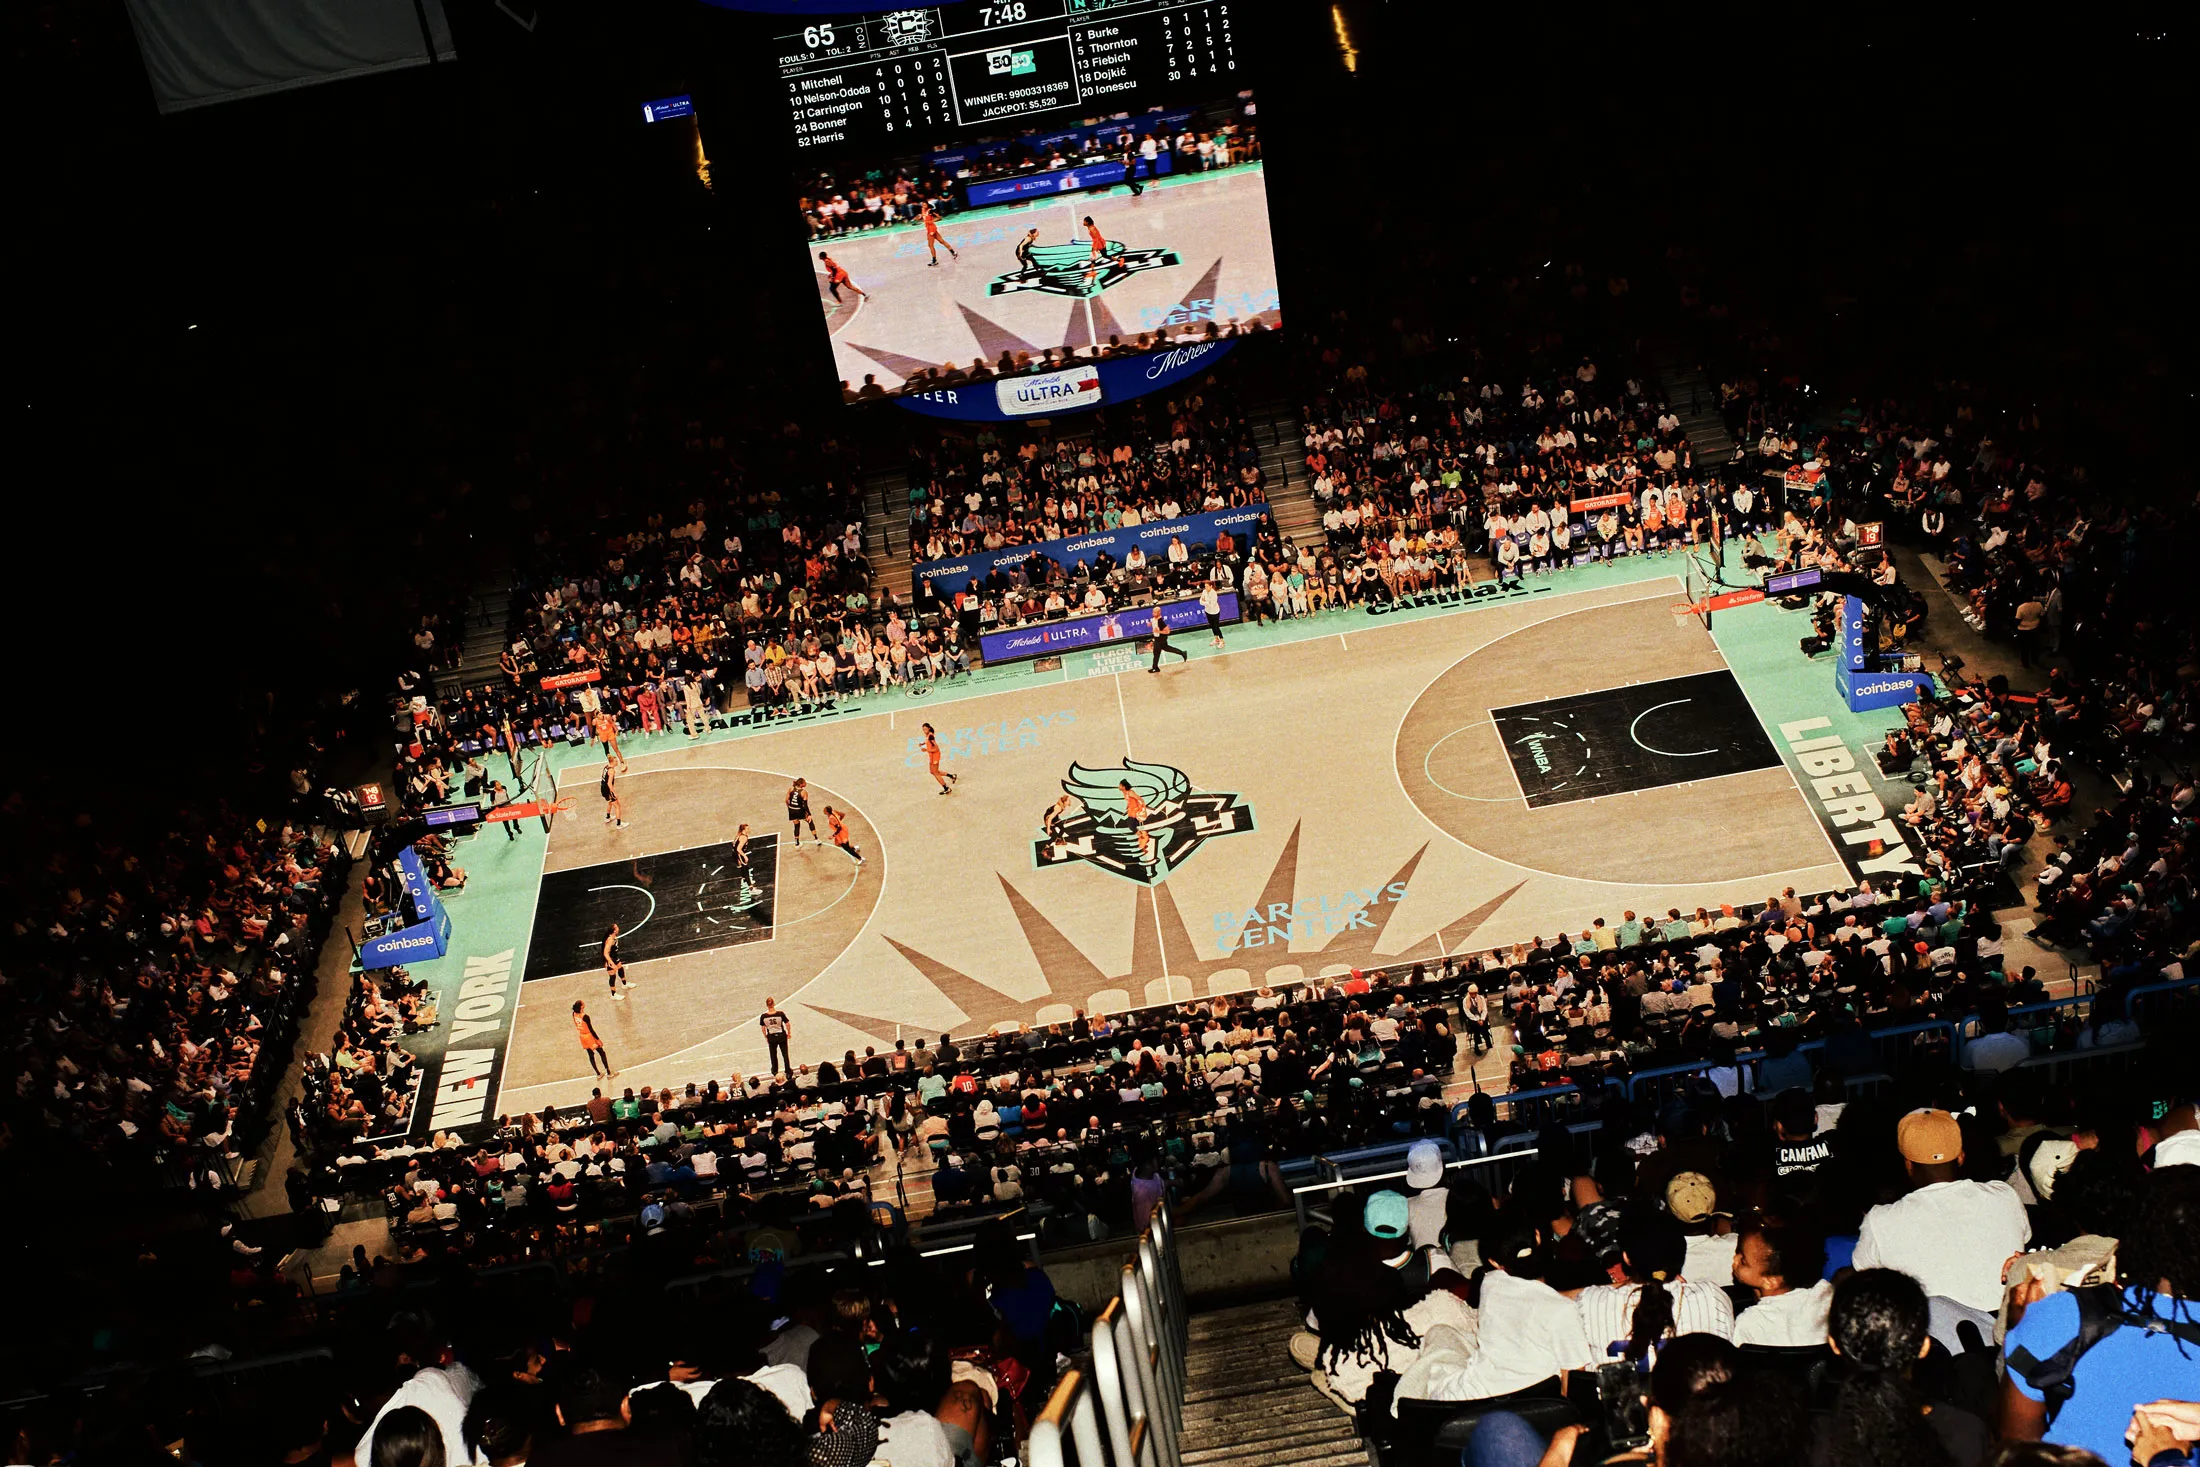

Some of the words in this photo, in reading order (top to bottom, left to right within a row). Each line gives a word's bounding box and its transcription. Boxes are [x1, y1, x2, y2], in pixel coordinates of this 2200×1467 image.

[979, 2, 1027, 26] 7:48
[1075, 33, 1082, 42] 2
[1087, 26, 1119, 40] Burke
[1163, 16, 1170, 26] 9
[1183, 12, 1189, 22] 1
[1203, 8, 1209, 18] 1
[1220, 5, 1228, 15] 2
[803, 23, 836, 48] 65
[855, 26, 867, 49] CON
[1077, 46, 1084, 56] 5
[1089, 37, 1138, 54] Thornton
[1165, 30, 1172, 40] 2
[1184, 26, 1191, 36] 0
[1205, 22, 1211, 32] 1
[1222, 19, 1230, 29] 2
[779, 53, 809, 64] FOULS:
[1077, 59, 1090, 70] 13
[1092, 52, 1131, 67] Fiebich
[1167, 43, 1174, 53] 7
[1186, 40, 1193, 50] 2
[1206, 36, 1213, 46] 5
[1224, 33, 1231, 42] 2
[789, 83, 797, 93] 3
[800, 74, 843, 91] Mitchell
[875, 67, 883, 77] 4
[895, 64, 902, 74] 0
[914, 61, 922, 70] 0
[933, 58, 940, 67] 2
[1079, 73, 1092, 84] 18
[1093, 66, 1127, 82] Dojkić
[1169, 57, 1176, 67] 5
[1188, 54, 1195, 63] 0
[1209, 50, 1215, 60] 1
[1227, 47, 1233, 56] 1
[790, 96, 802, 107] 10
[803, 85, 871, 105] Nelson-Ododa
[878, 81, 886, 91] 0
[897, 78, 905, 88] 0
[917, 75, 924, 84] 0
[936, 71, 943, 81] 0
[1081, 86, 1094, 97] 20
[1096, 79, 1137, 95] Ionescu
[1168, 70, 1181, 81] 30
[1190, 67, 1197, 77] 4
[1209, 64, 1217, 73] 4
[1228, 60, 1235, 70] 0
[793, 110, 805, 121] 21
[807, 100, 863, 118] Carrington
[879, 94, 891, 105] 10
[901, 92, 907, 101] 1
[919, 88, 927, 97] 4
[938, 85, 946, 95] 3
[963, 92, 1008, 107] WINNER:
[1008, 81, 1069, 99] 99003318369
[795, 123, 808, 134] 24
[809, 117, 847, 131] Bonner
[883, 108, 891, 118] 8
[904, 105, 910, 115] 1
[922, 102, 930, 111] 6
[940, 98, 948, 108] 2
[982, 102, 1028, 117] JACKPOT:
[1029, 97, 1057, 109] $5,520
[798, 137, 811, 147] 52
[812, 131, 845, 145] Harris
[886, 122, 894, 132] 8
[905, 119, 913, 128] 4
[926, 115, 932, 124] 1
[943, 112, 951, 122] 2
[1023, 179, 1053, 191] ULTRA
[913, 390, 959, 405] EER
[1017, 383, 1075, 402] ULTRA
[1584, 498, 1618, 509] GATORADE
[1139, 523, 1190, 539] coinbase
[1066, 535, 1116, 553] coinbase
[993, 552, 1041, 567] coinba
[919, 563, 969, 579] coinbase
[1171, 611, 1194, 620] LIGHT
[1006, 636, 1042, 650] Michelob
[1051, 627, 1088, 641] ULTRA
[1092, 647, 1134, 660] BLACK
[1096, 655, 1132, 667] LIVES
[1087, 660, 1144, 677] MATTER
[554, 675, 588, 687] GATORADE
[1855, 679, 1914, 697] coinbase
[904, 731, 1042, 768] CNTER
[1527, 739, 1552, 775] WNBA
[1778, 716, 1925, 876] LIBERTY
[1213, 881, 1409, 932] BARCLAYS
[1216, 910, 1378, 952] CENTER
[377, 936, 434, 953] coinbase
[448, 948, 516, 1045] YORK
[1545, 1056, 1557, 1067] 35
[429, 1047, 496, 1131] NEW
[961, 1080, 973, 1092] 10
[1192, 1076, 1204, 1087] 35
[732, 1087, 742, 1098] 35
[1780, 1142, 1830, 1163] CAMFAM
[1029, 1166, 1040, 1177] 30
